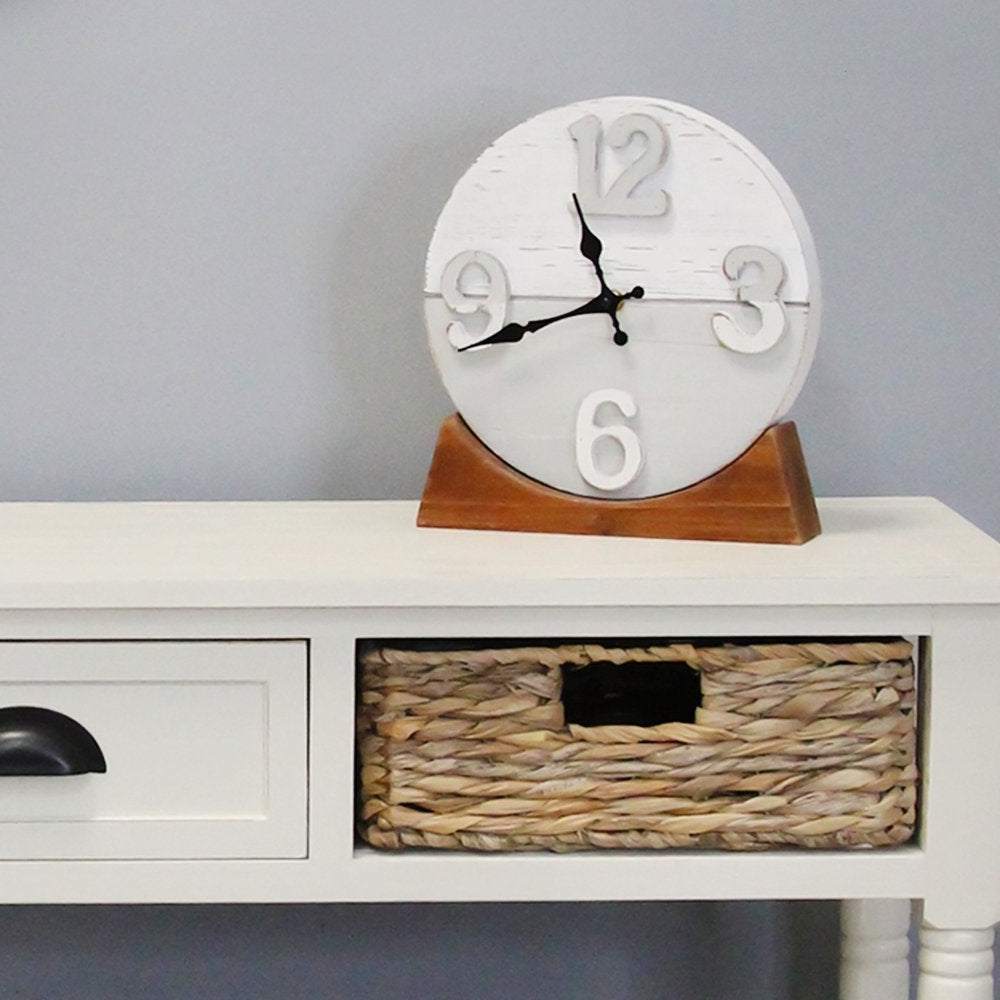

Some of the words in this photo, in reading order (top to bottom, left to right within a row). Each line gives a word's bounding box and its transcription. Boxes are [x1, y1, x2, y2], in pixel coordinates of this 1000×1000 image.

[567, 113, 671, 217] 12
[440, 249, 511, 351] 9
[710, 245, 787, 355] 3
[575, 388, 644, 492] 6
